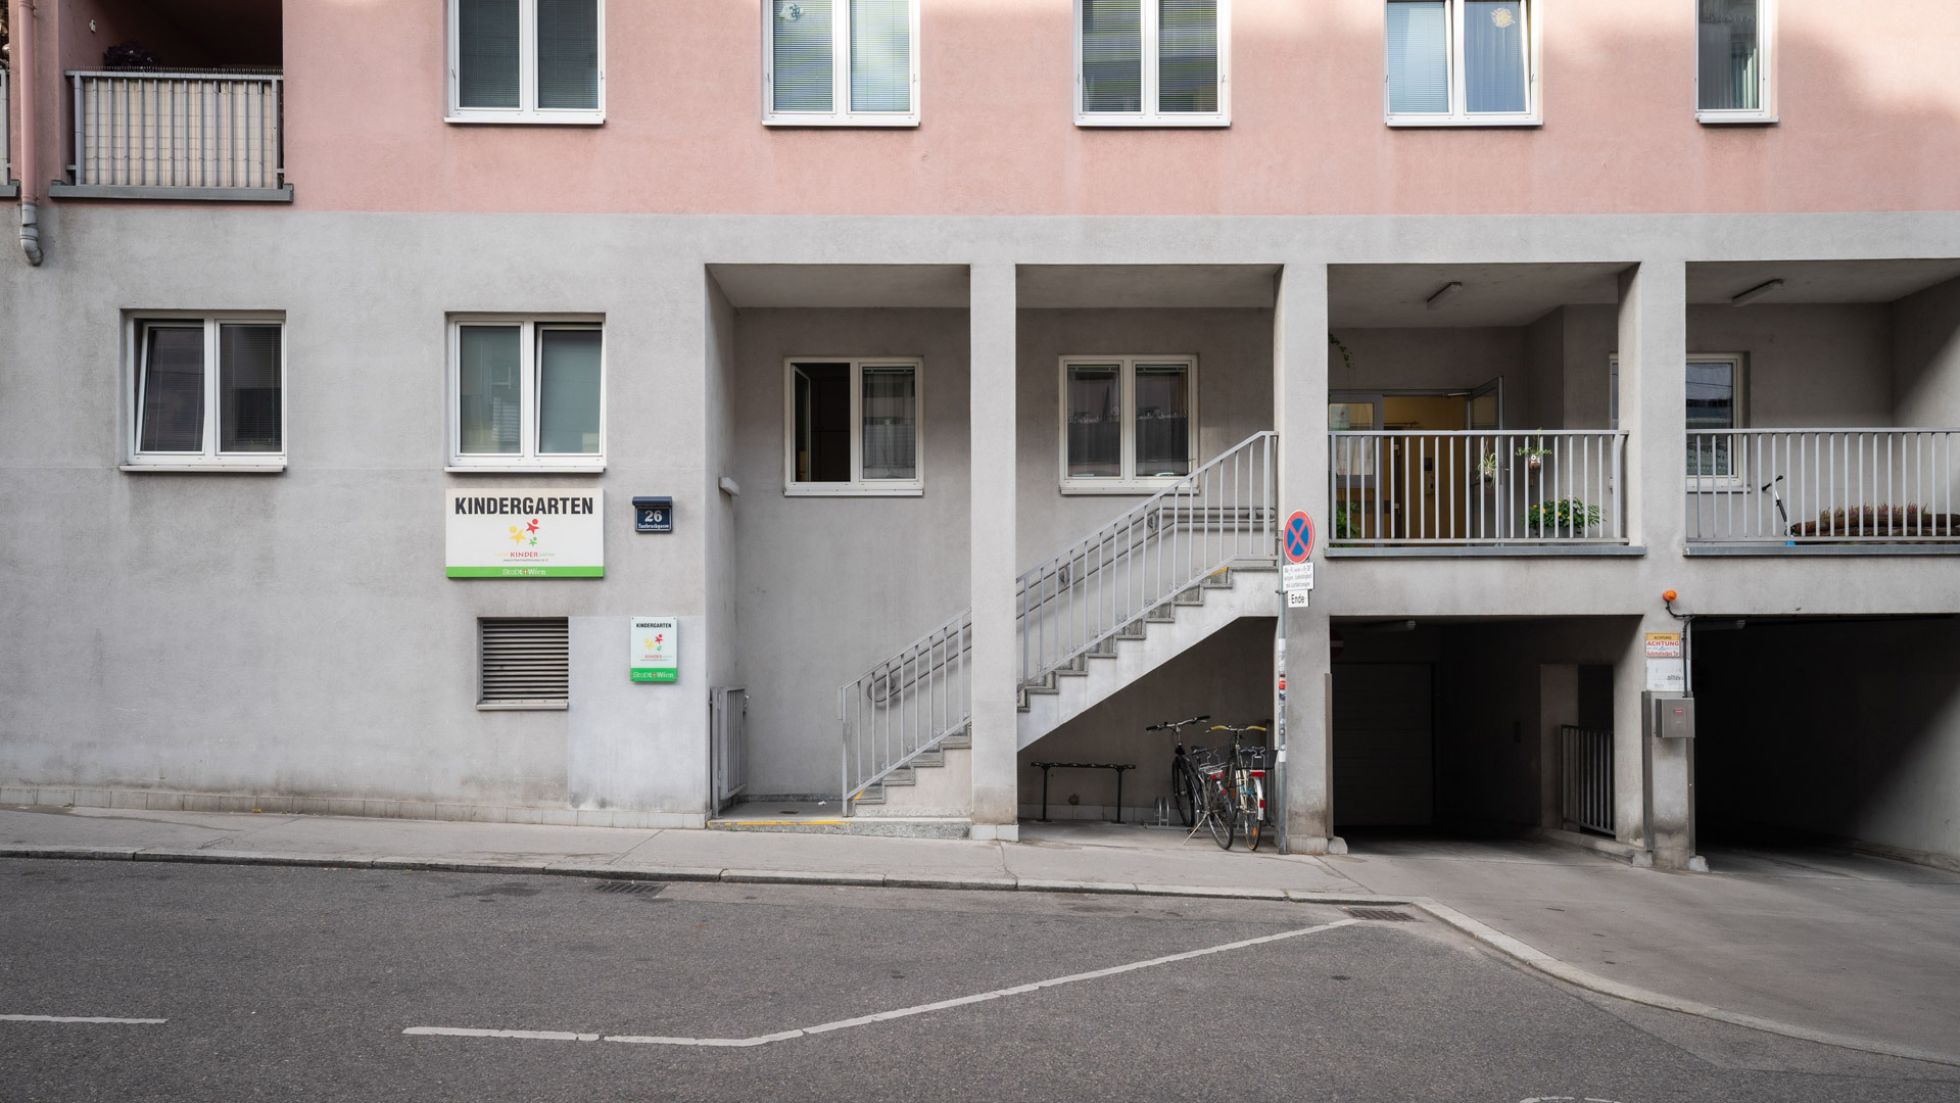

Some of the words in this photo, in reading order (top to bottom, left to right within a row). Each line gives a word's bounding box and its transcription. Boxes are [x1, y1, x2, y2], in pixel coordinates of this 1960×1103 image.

[455, 497, 593, 515] KINDERGARTEN
[644, 510, 663, 522] 26
[1291, 593, 1305, 604] Ende
